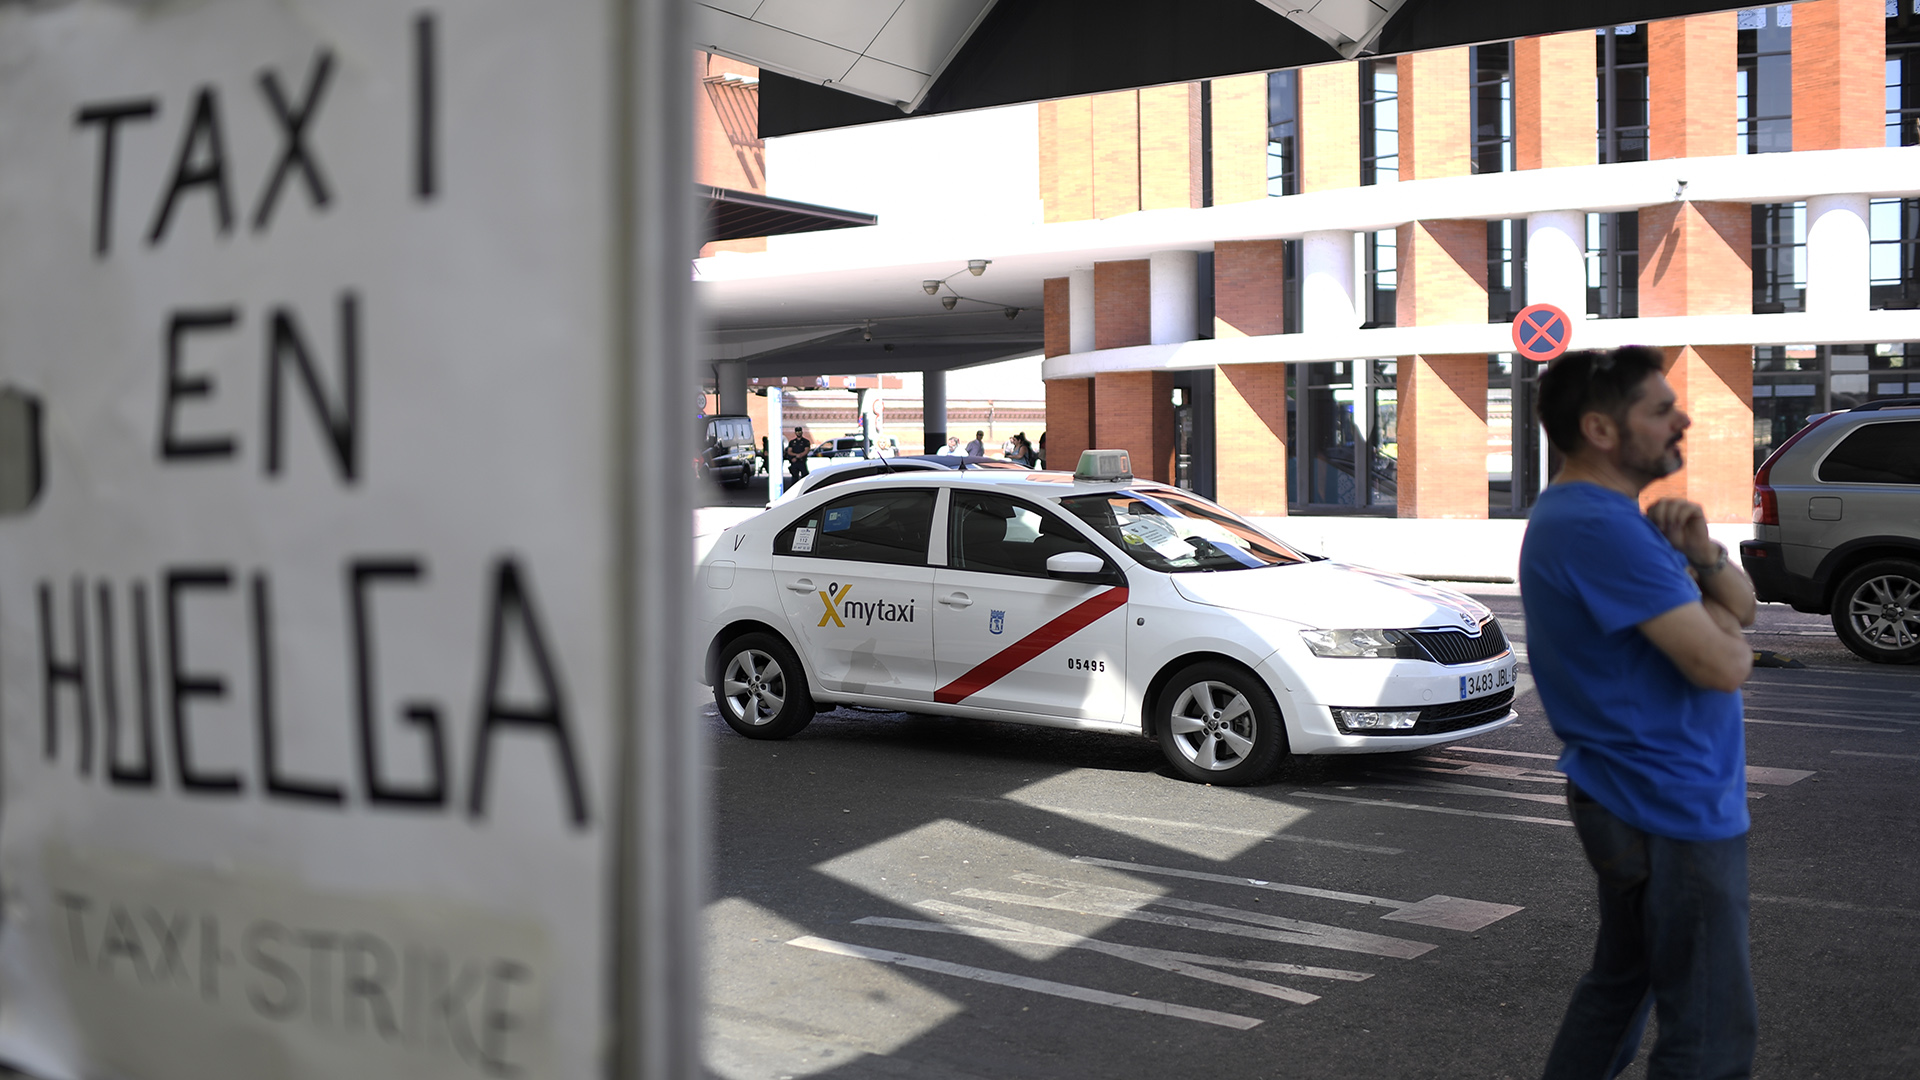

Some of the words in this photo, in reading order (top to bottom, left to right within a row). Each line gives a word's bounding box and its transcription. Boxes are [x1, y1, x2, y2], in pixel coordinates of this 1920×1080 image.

[75, 10, 438, 260] TAXI
[156, 293, 360, 488] EN
[844, 598, 914, 626] mytaxi
[1067, 657, 1105, 673] 05495
[38, 560, 593, 830] HUELGA
[1468, 673, 1493, 695] 3483
[1495, 668, 1509, 687] JBL
